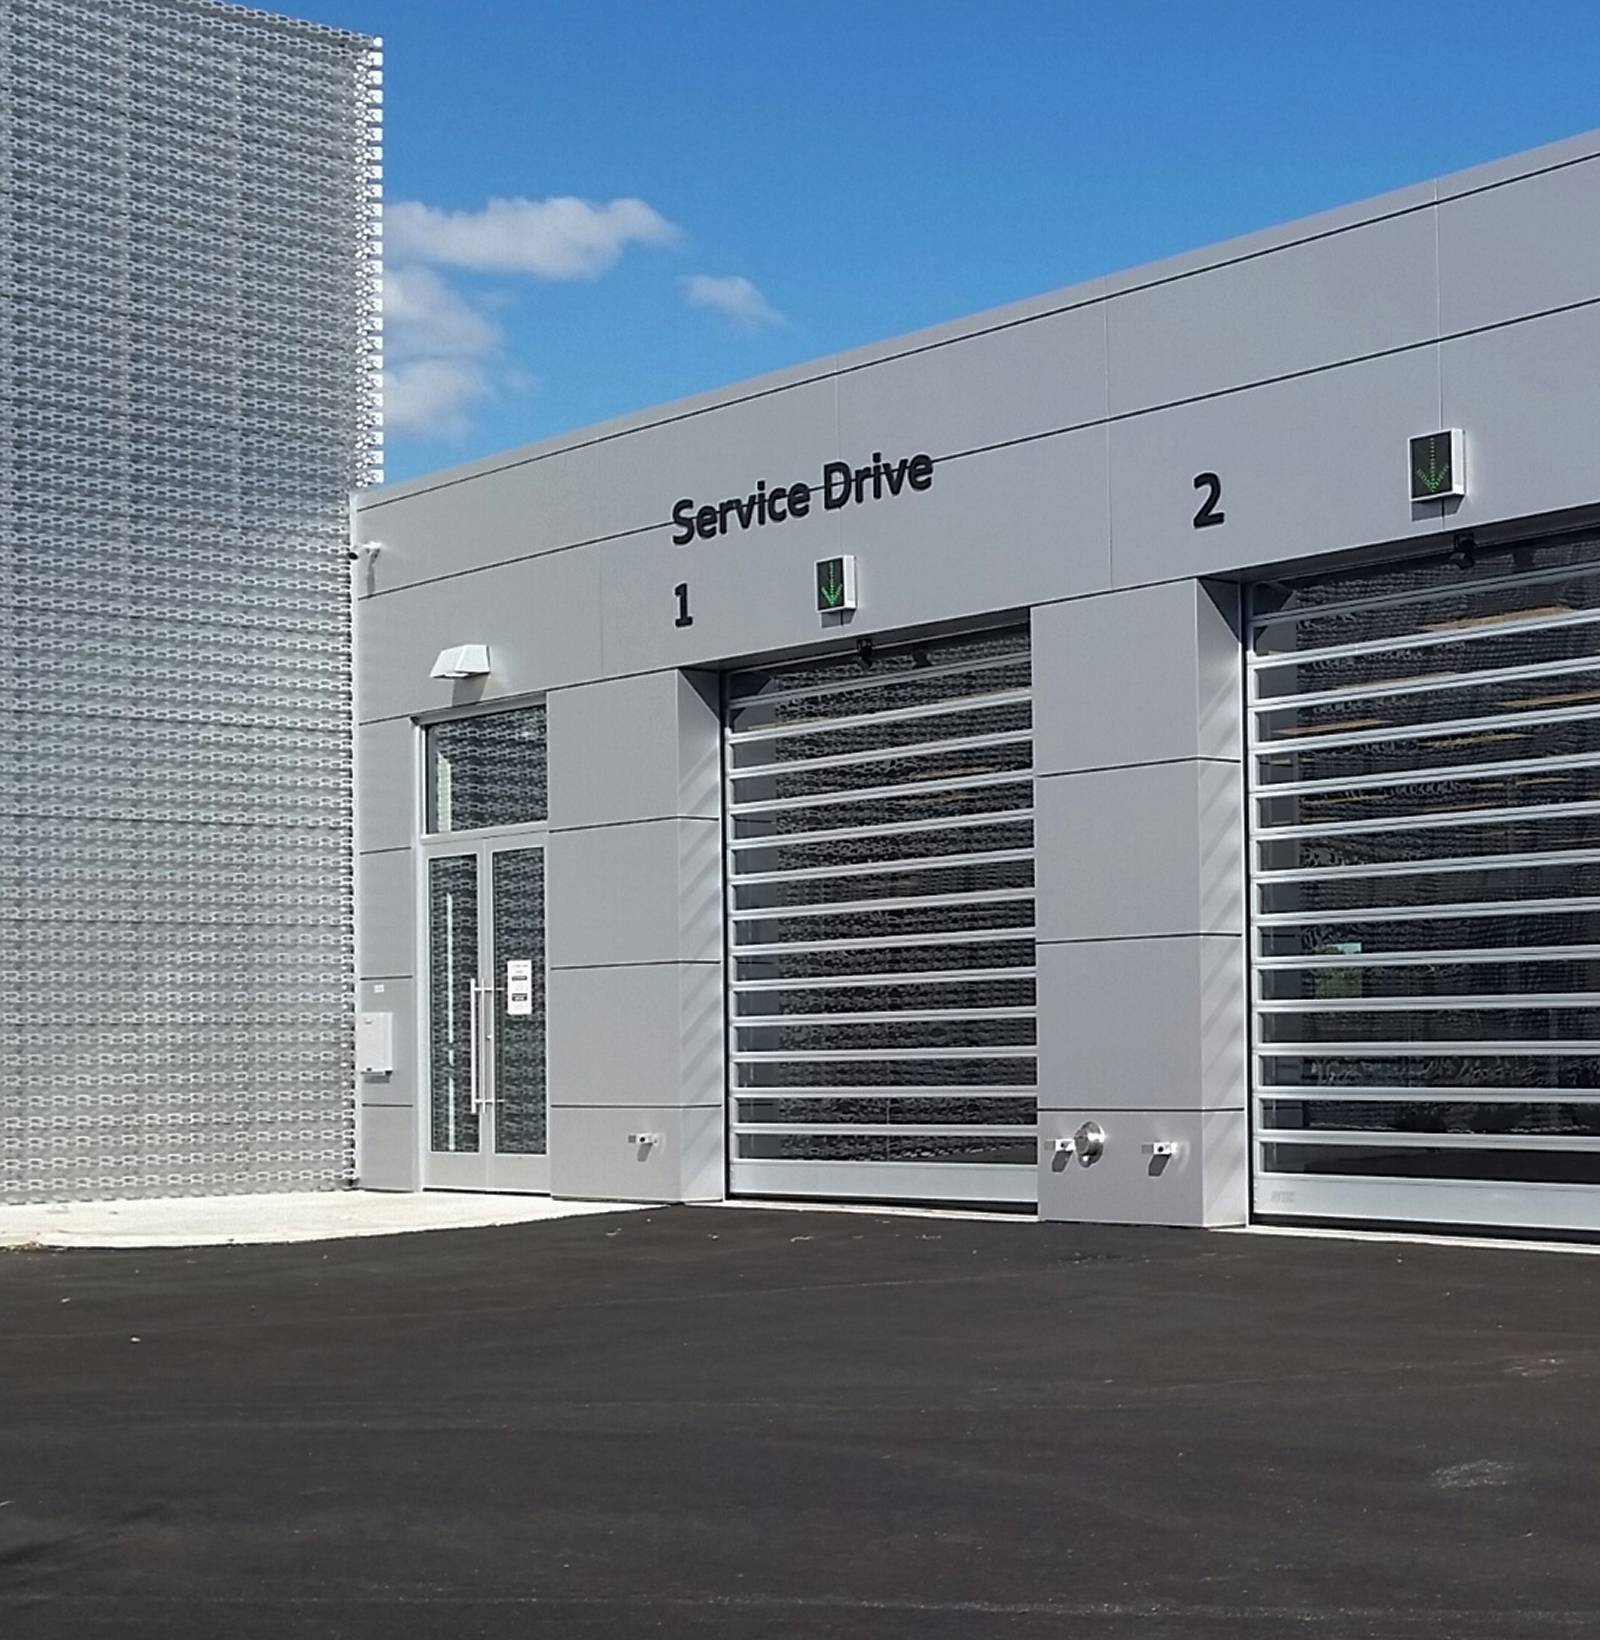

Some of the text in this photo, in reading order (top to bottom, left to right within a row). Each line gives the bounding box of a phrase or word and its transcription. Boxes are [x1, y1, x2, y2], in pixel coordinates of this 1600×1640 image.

[671, 452, 934, 545] Service Drive
[1193, 472, 1225, 529] 2
[674, 583, 693, 628] 1
